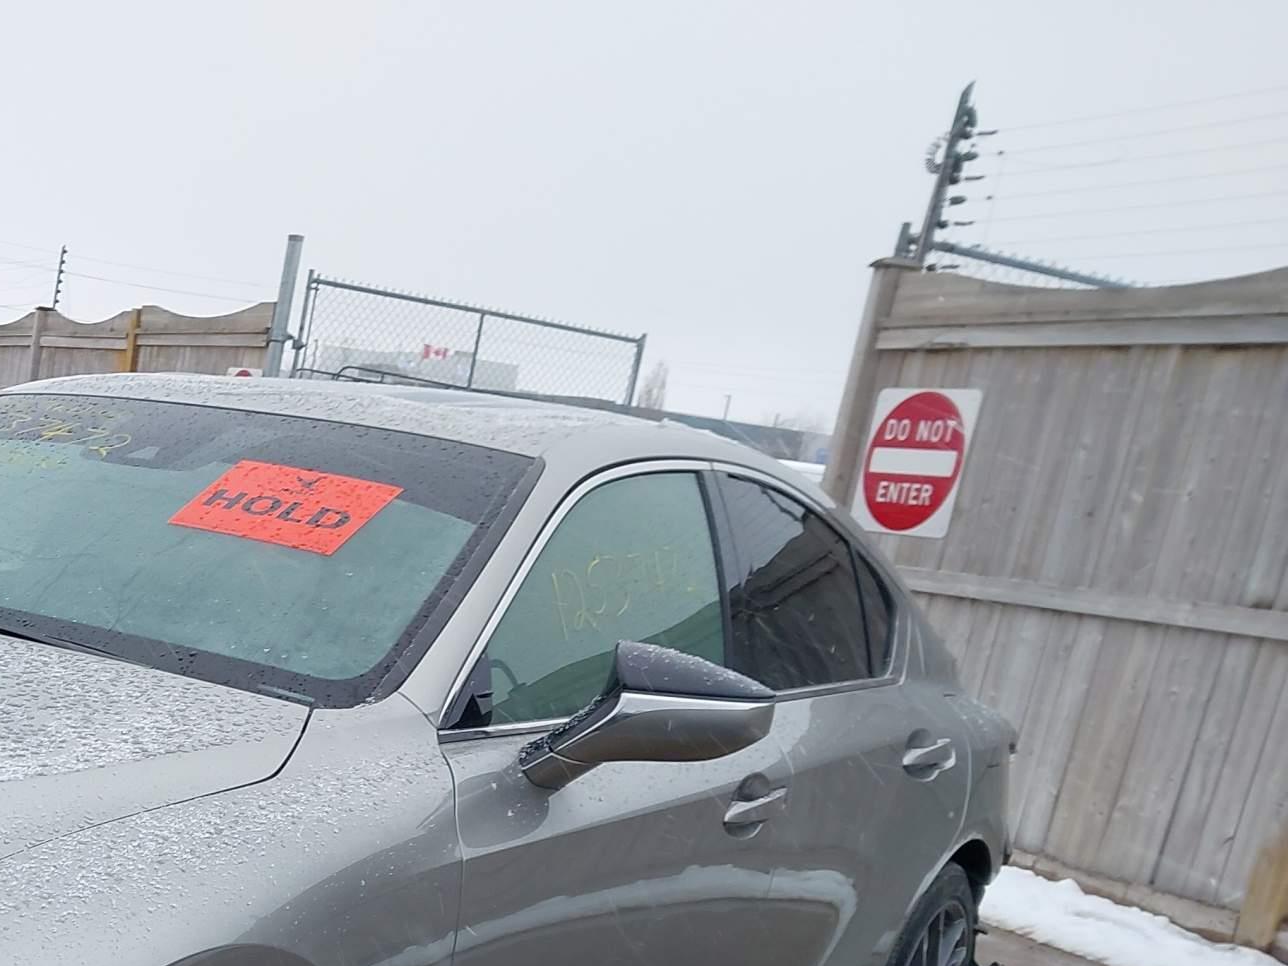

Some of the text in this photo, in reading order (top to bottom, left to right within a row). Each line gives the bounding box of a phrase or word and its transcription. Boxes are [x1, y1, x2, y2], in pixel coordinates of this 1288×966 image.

[884, 418, 958, 443] DO NOT
[875, 480, 934, 506] ENTER
[202, 488, 352, 530] HOLD
